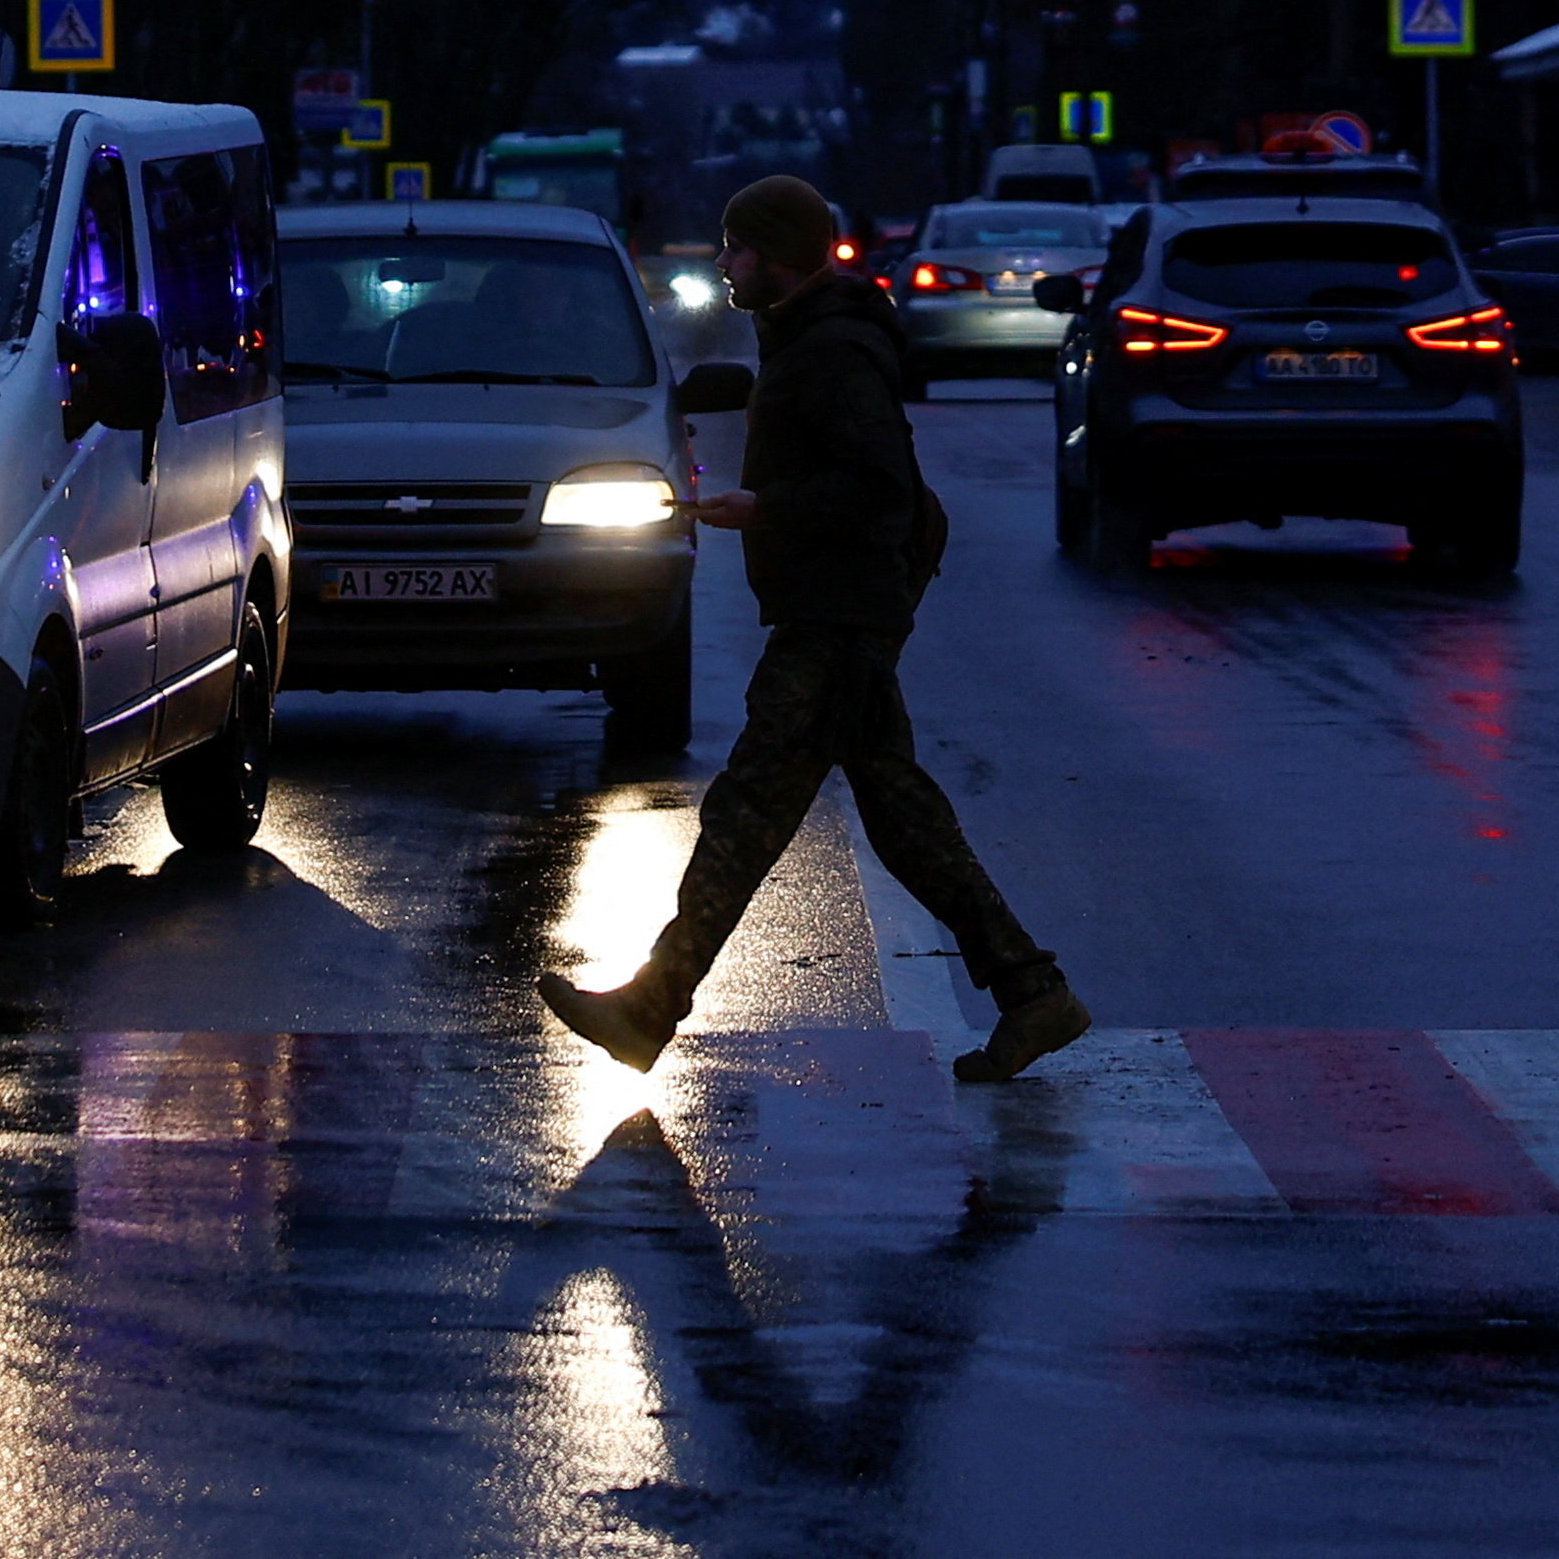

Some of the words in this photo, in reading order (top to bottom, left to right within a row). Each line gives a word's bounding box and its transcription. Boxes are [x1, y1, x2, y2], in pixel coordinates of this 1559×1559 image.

[340, 570, 371, 595] AI
[384, 570, 443, 596] 9752
[451, 570, 487, 595] AX
